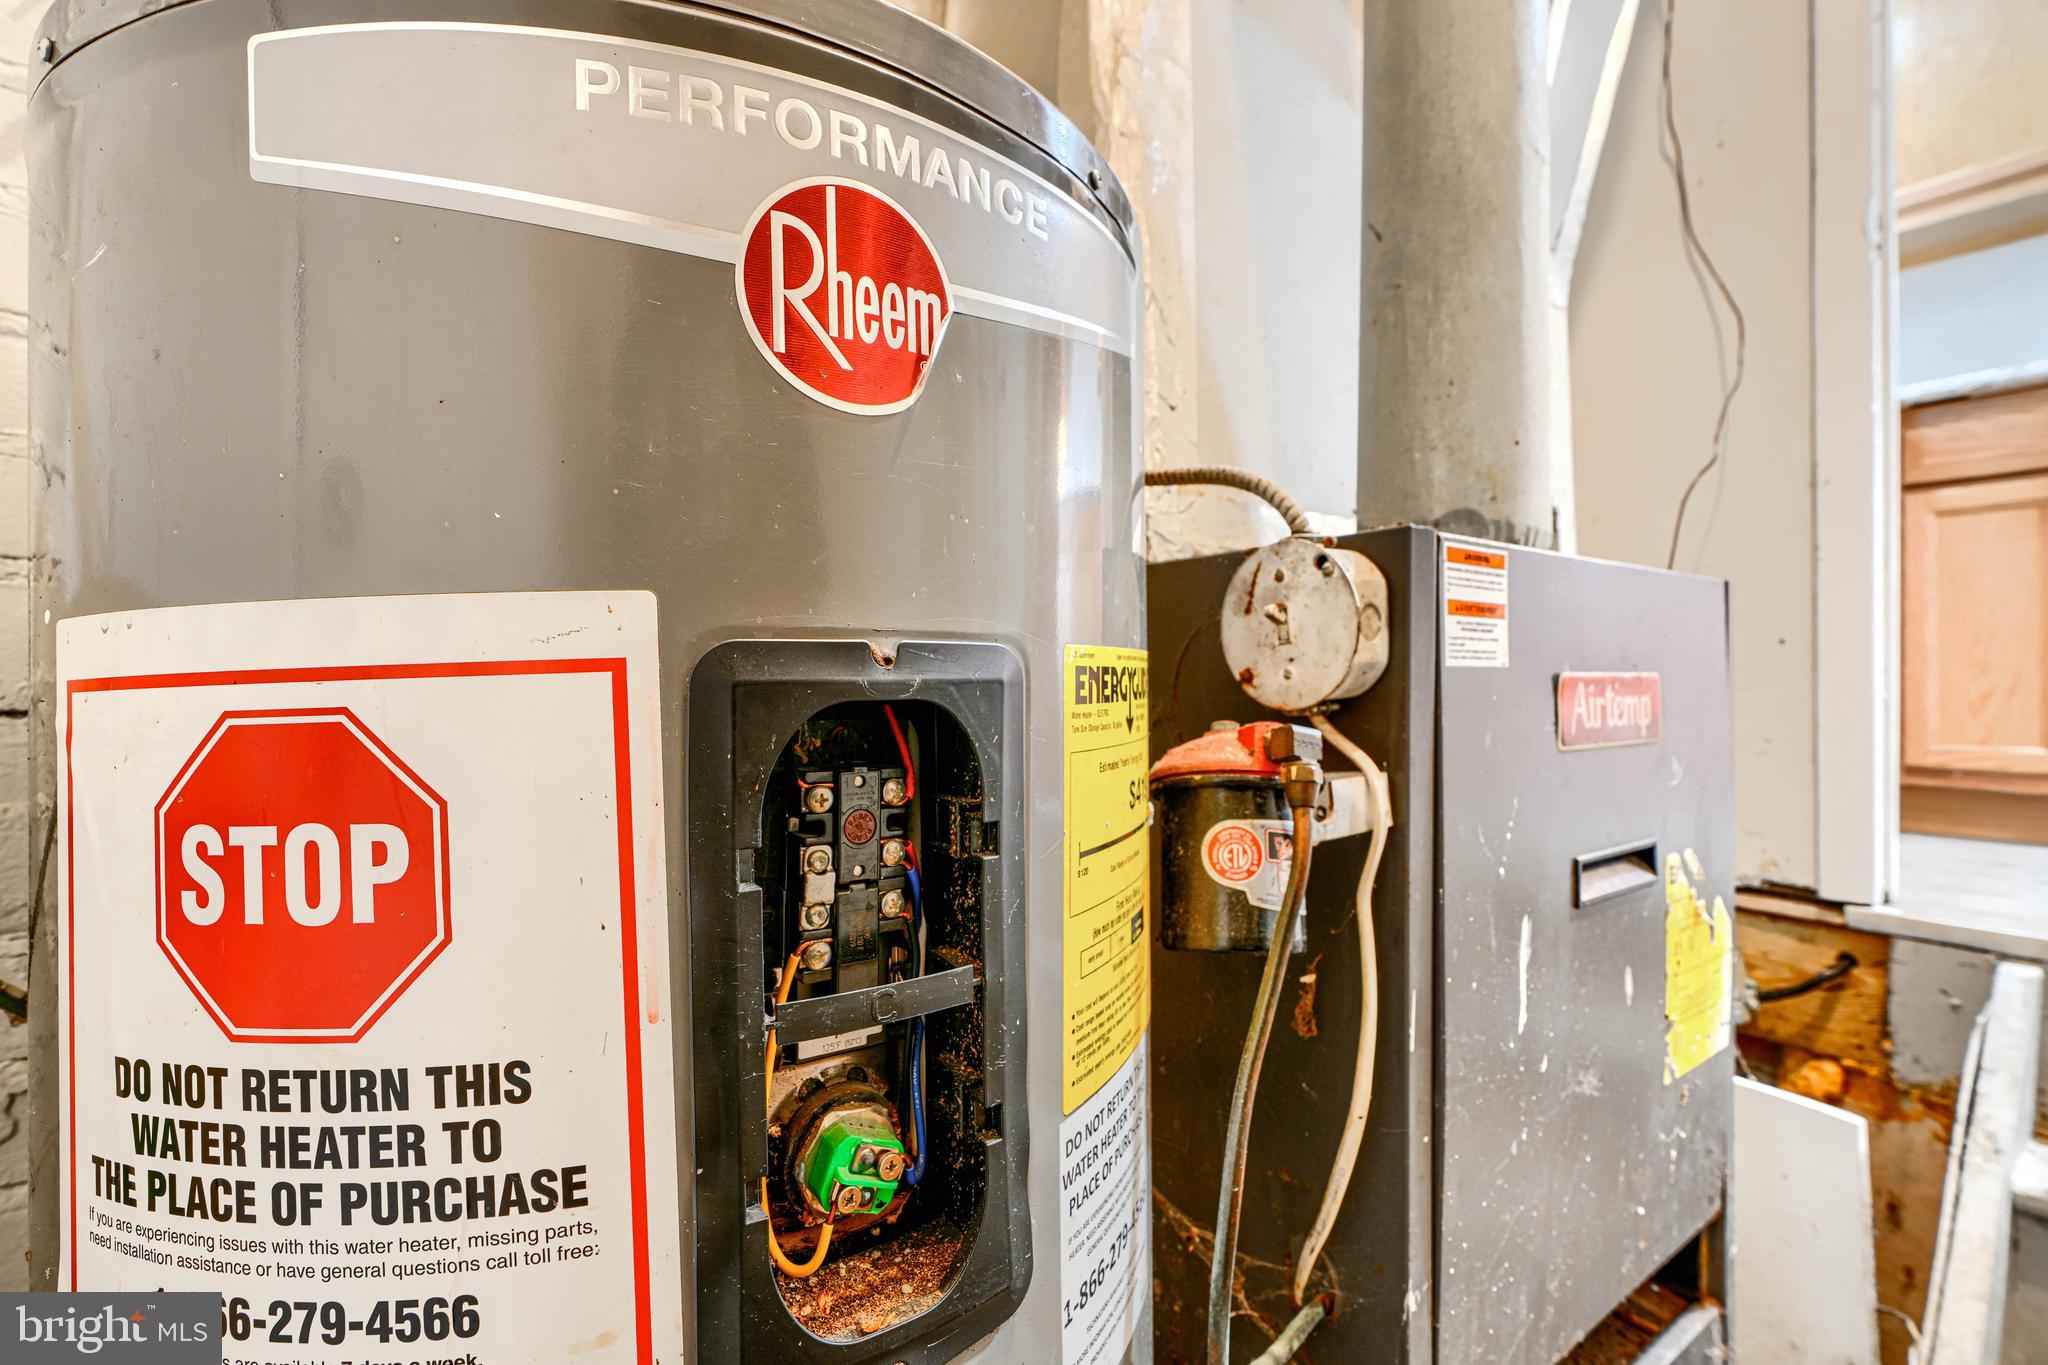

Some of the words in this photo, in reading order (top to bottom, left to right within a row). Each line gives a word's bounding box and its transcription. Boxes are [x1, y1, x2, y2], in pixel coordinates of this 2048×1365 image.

[573, 58, 1050, 242] PERFORMANCE
[769, 186, 942, 371] Rheem
[1571, 681, 1652, 737] Airtemp
[180, 822, 410, 927] STOP
[114, 1056, 151, 1102] DO
[162, 1063, 229, 1110] NOT
[242, 1068, 409, 1114] RETURN
[425, 1060, 532, 1109] THIS
[131, 1113, 247, 1168] WATER
[260, 1124, 427, 1169] HEATER
[442, 1118, 502, 1165] TO
[1062, 1145, 1099, 1191] WATER
[1100, 1108, 1128, 1155] HEATER
[1065, 1131, 1082, 1158] DO
[1085, 1107, 1105, 1141] NOT
[91, 1154, 138, 1208] THE
[147, 1169, 257, 1224] PLACE
[271, 1181, 323, 1227] OF
[340, 1165, 589, 1226] PURCHASE
[1069, 1171, 1100, 1217] PLACE
[1102, 1155, 1113, 1181] OF
[89, 1205, 95, 1220] If
[96, 1212, 113, 1227] you
[116, 1219, 132, 1234] are
[135, 1224, 215, 1252] experiencing
[219, 1235, 267, 1253] issues
[272, 1239, 303, 1254] with
[309, 1239, 339, 1255] this
[344, 1239, 393, 1255] water
[399, 1236, 461, 1252] heater,
[468, 1228, 539, 1248] missing
[545, 1221, 598, 1243] parts,
[89, 1230, 112, 1249] need
[114, 1237, 172, 1266] installation
[176, 1255, 251, 1276] assistance
[256, 1264, 272, 1277] or
[276, 1262, 315, 1278] have
[321, 1261, 386, 1282] general
[392, 1258, 480, 1280] questions
[486, 1252, 517, 1270] call
[523, 1247, 551, 1266] toll
[557, 1244, 599, 1261] free:
[222, 1294, 480, 1345] 6-279-4566
